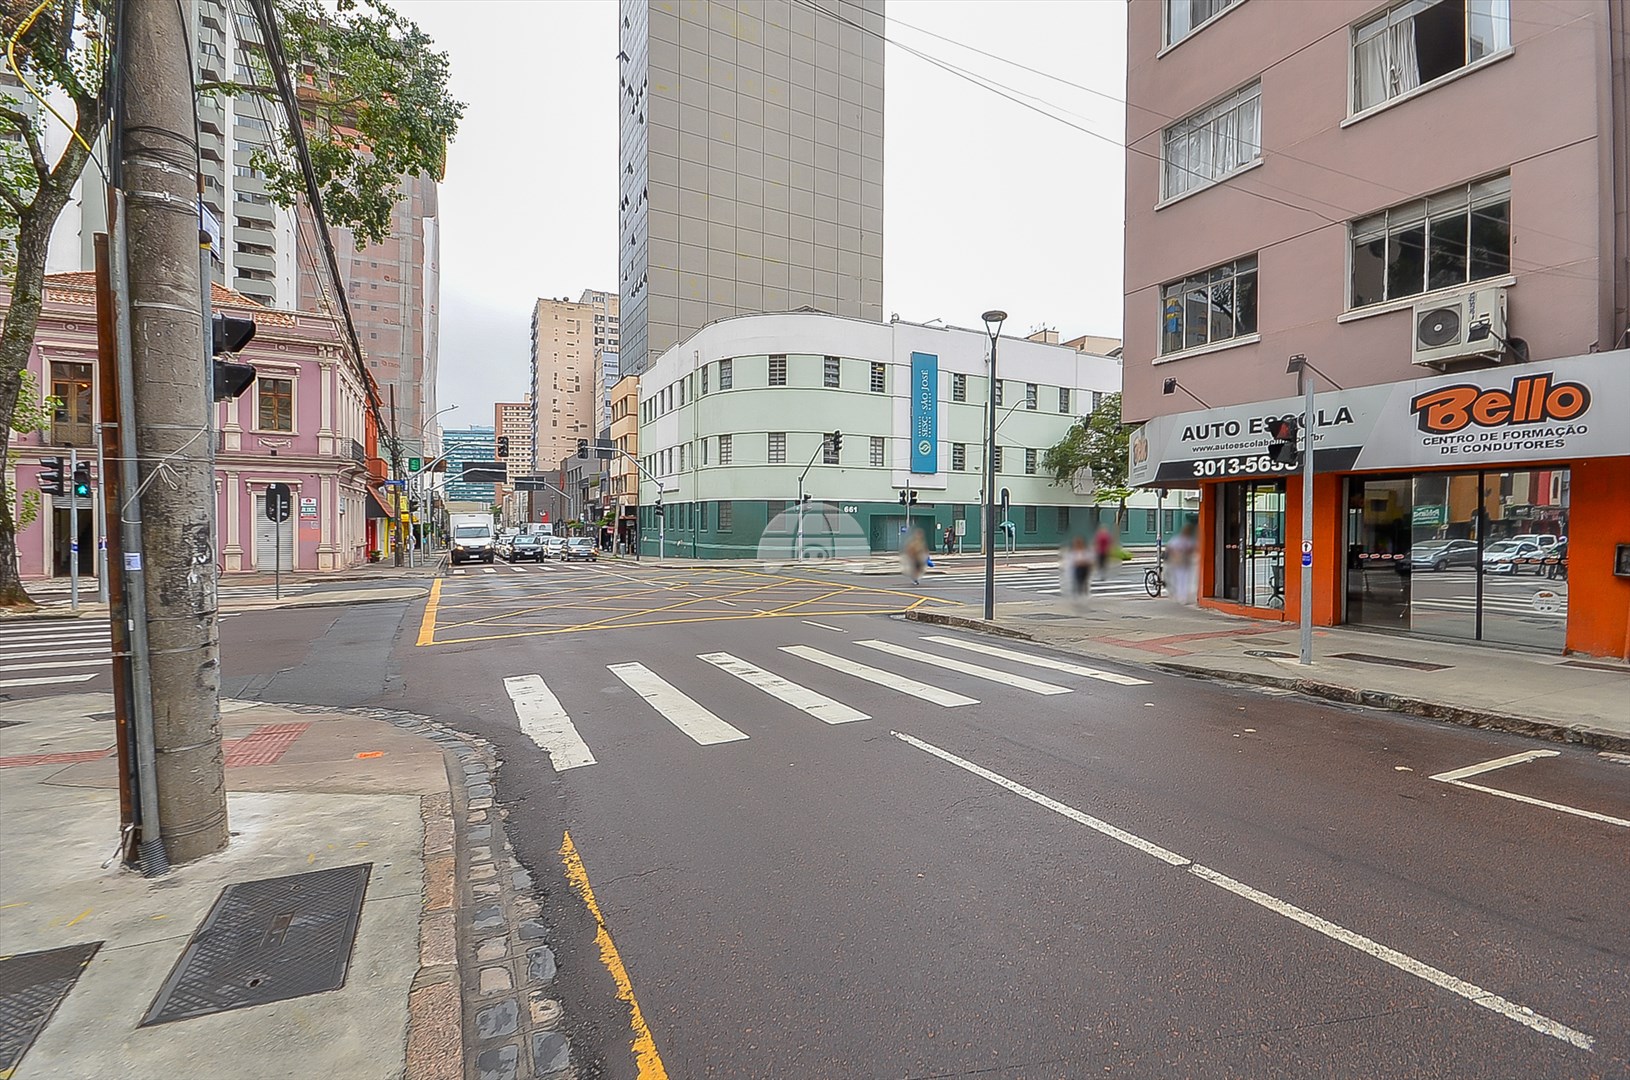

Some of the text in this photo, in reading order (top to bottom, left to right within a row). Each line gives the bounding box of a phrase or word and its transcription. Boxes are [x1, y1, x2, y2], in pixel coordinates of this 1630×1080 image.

[921, 369, 930, 391] JOSÉ
[1412, 374, 1590, 433] Bello
[921, 416, 929, 437] SESC
[1181, 407, 1354, 441] AUTO ESOLA
[1423, 424, 1588, 446] CENTRO DE FORMAÇÃO
[1440, 439, 1565, 454] DE CONDUTORES
